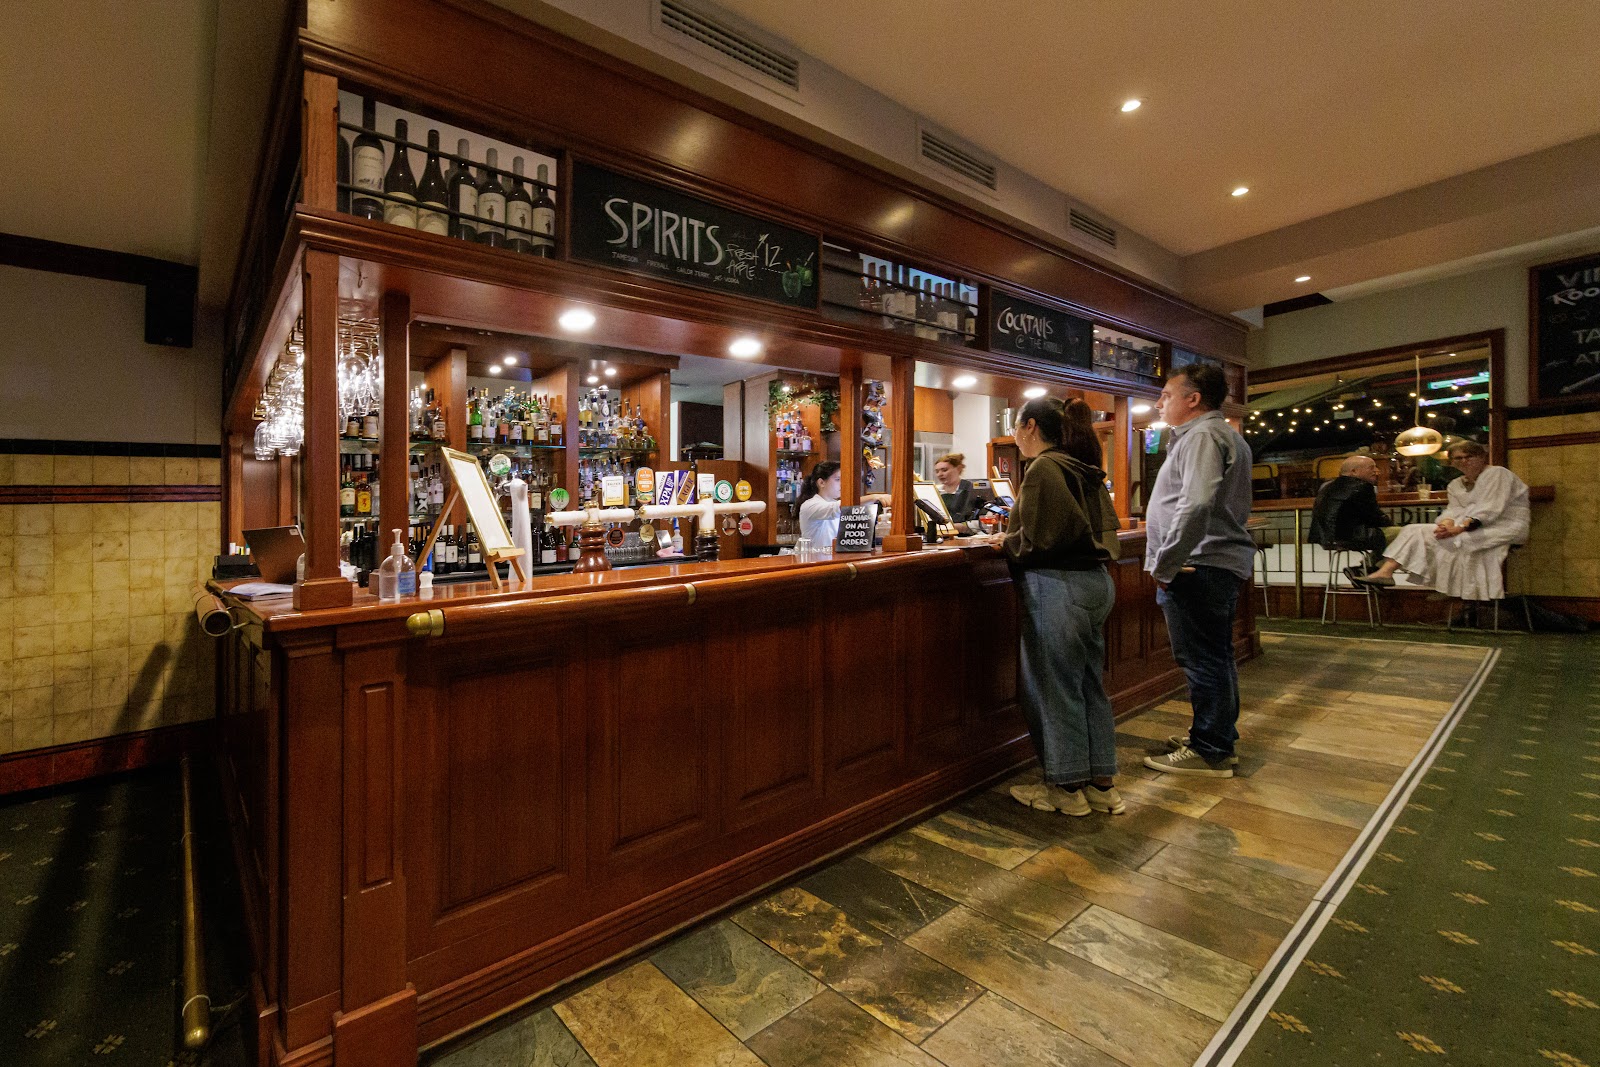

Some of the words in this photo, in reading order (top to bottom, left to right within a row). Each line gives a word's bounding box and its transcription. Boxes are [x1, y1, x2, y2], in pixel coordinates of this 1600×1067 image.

[604, 198, 723, 266] SPIRITS
[659, 487, 673, 506] XPA
[851, 505, 866, 515] 10%
[857, 522, 870, 530] ALL
[844, 530, 866, 538] FOOD
[840, 538, 869, 546] ORDERS
